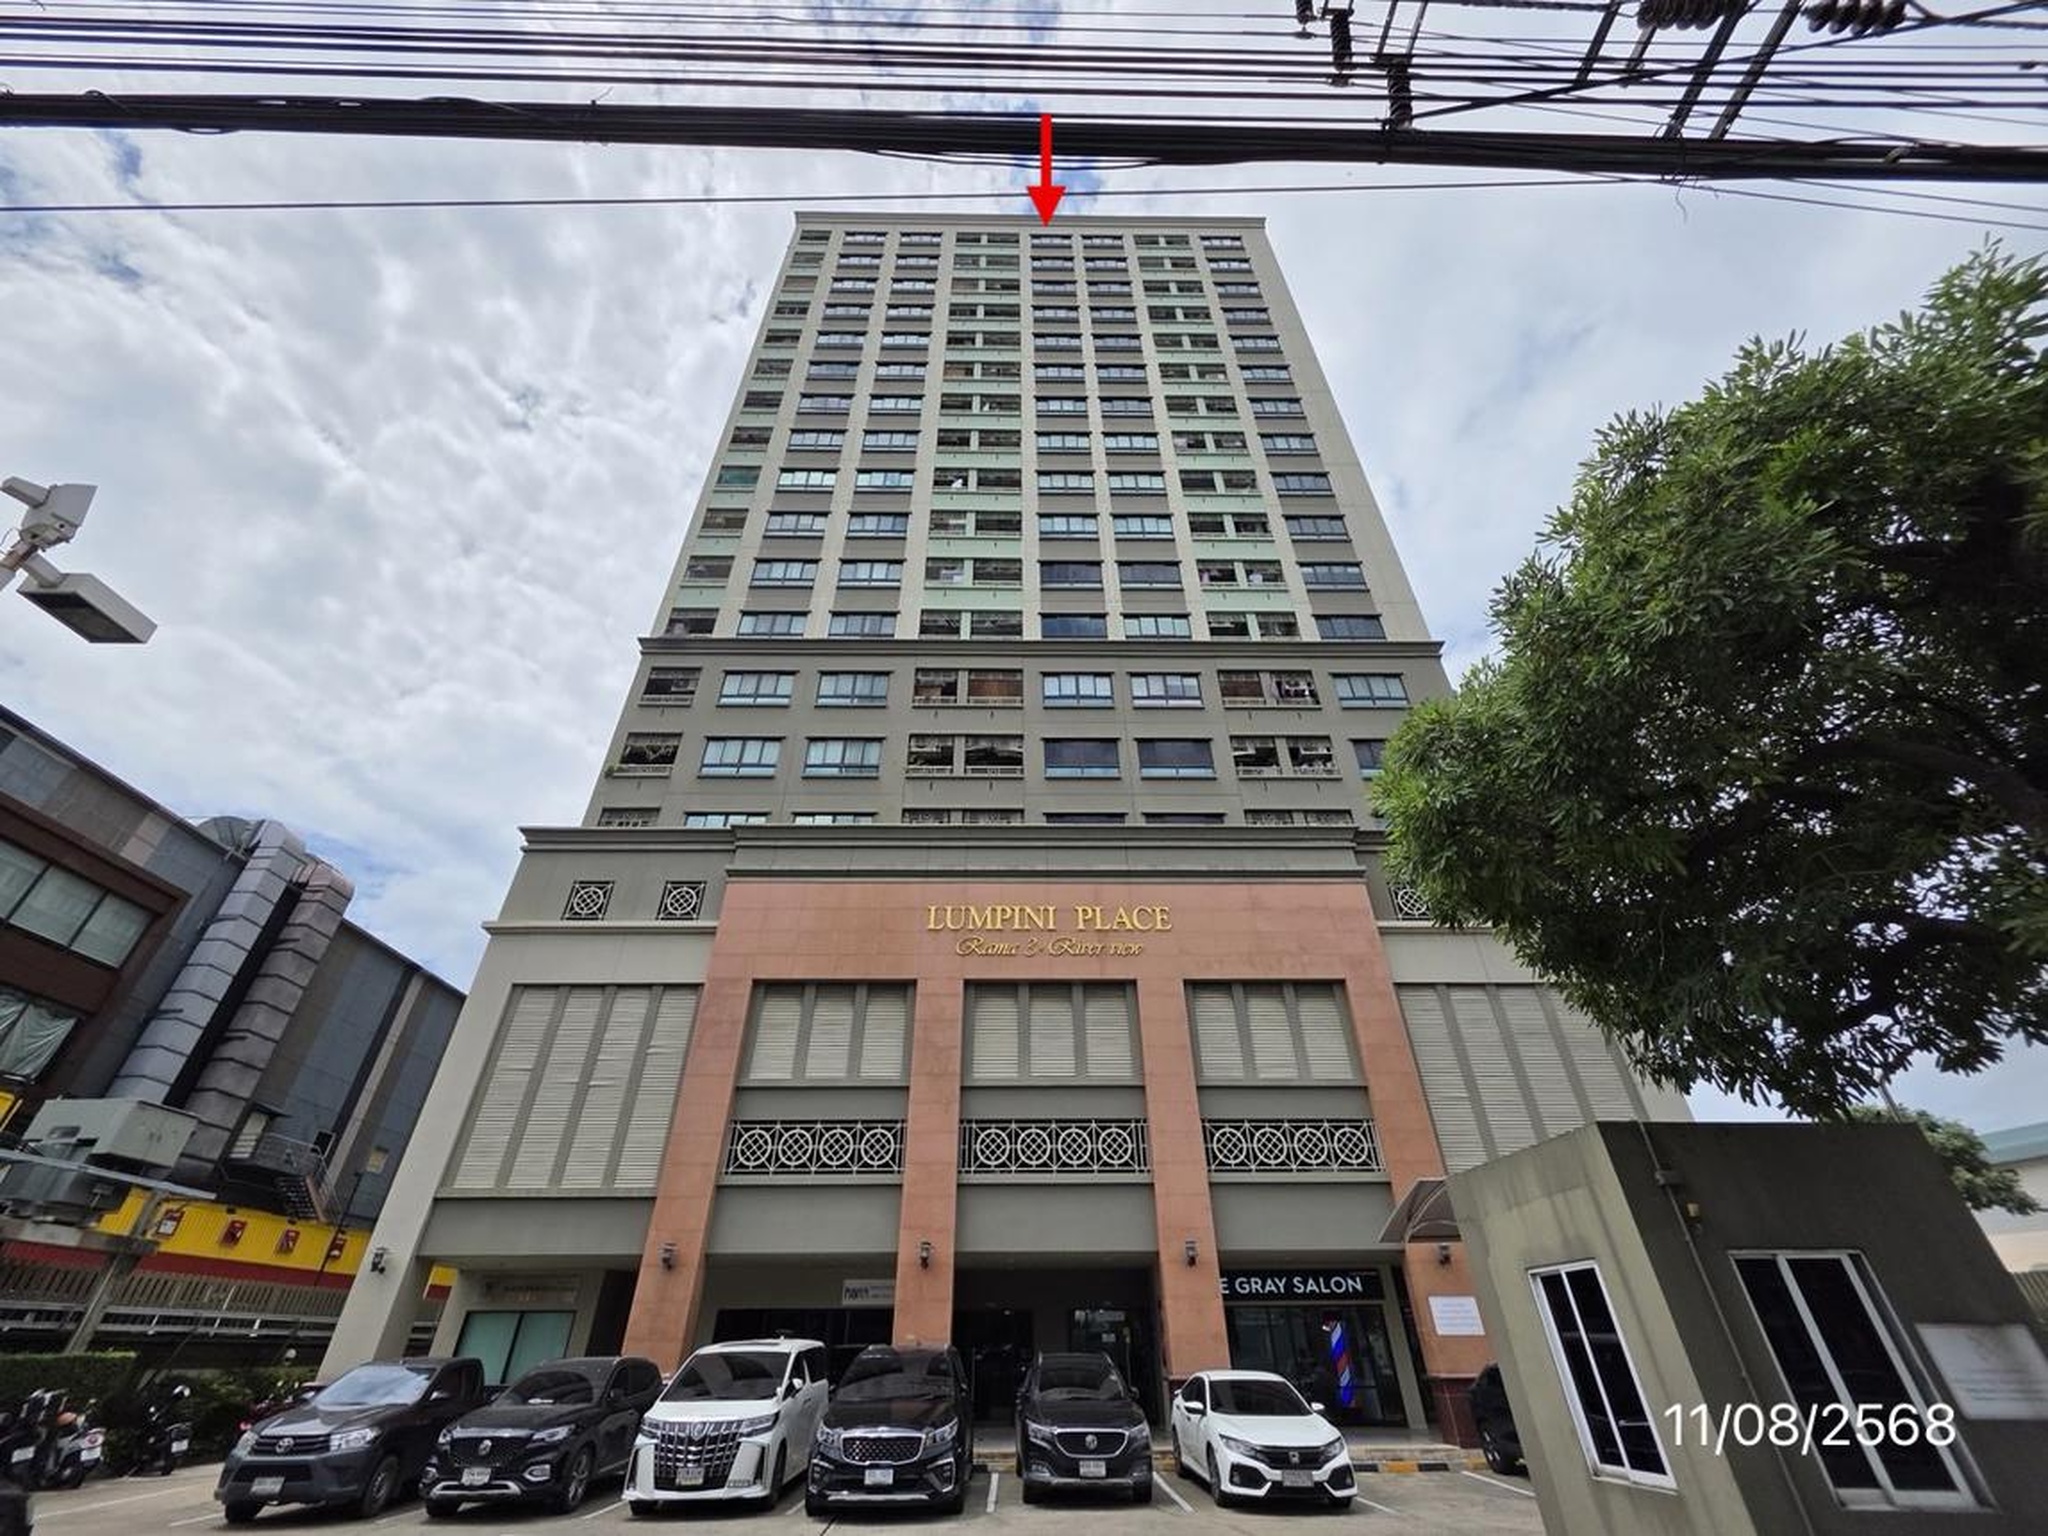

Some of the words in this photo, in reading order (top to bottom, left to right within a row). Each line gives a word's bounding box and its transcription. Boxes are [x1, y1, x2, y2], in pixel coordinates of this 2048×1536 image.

[927, 904, 1057, 931] LUMPINI
[1074, 904, 1173, 931] PLACE
[956, 935, 1020, 957] Rama
[1234, 1276, 1287, 1295] GRAY
[1293, 1277, 1364, 1295] SALON
